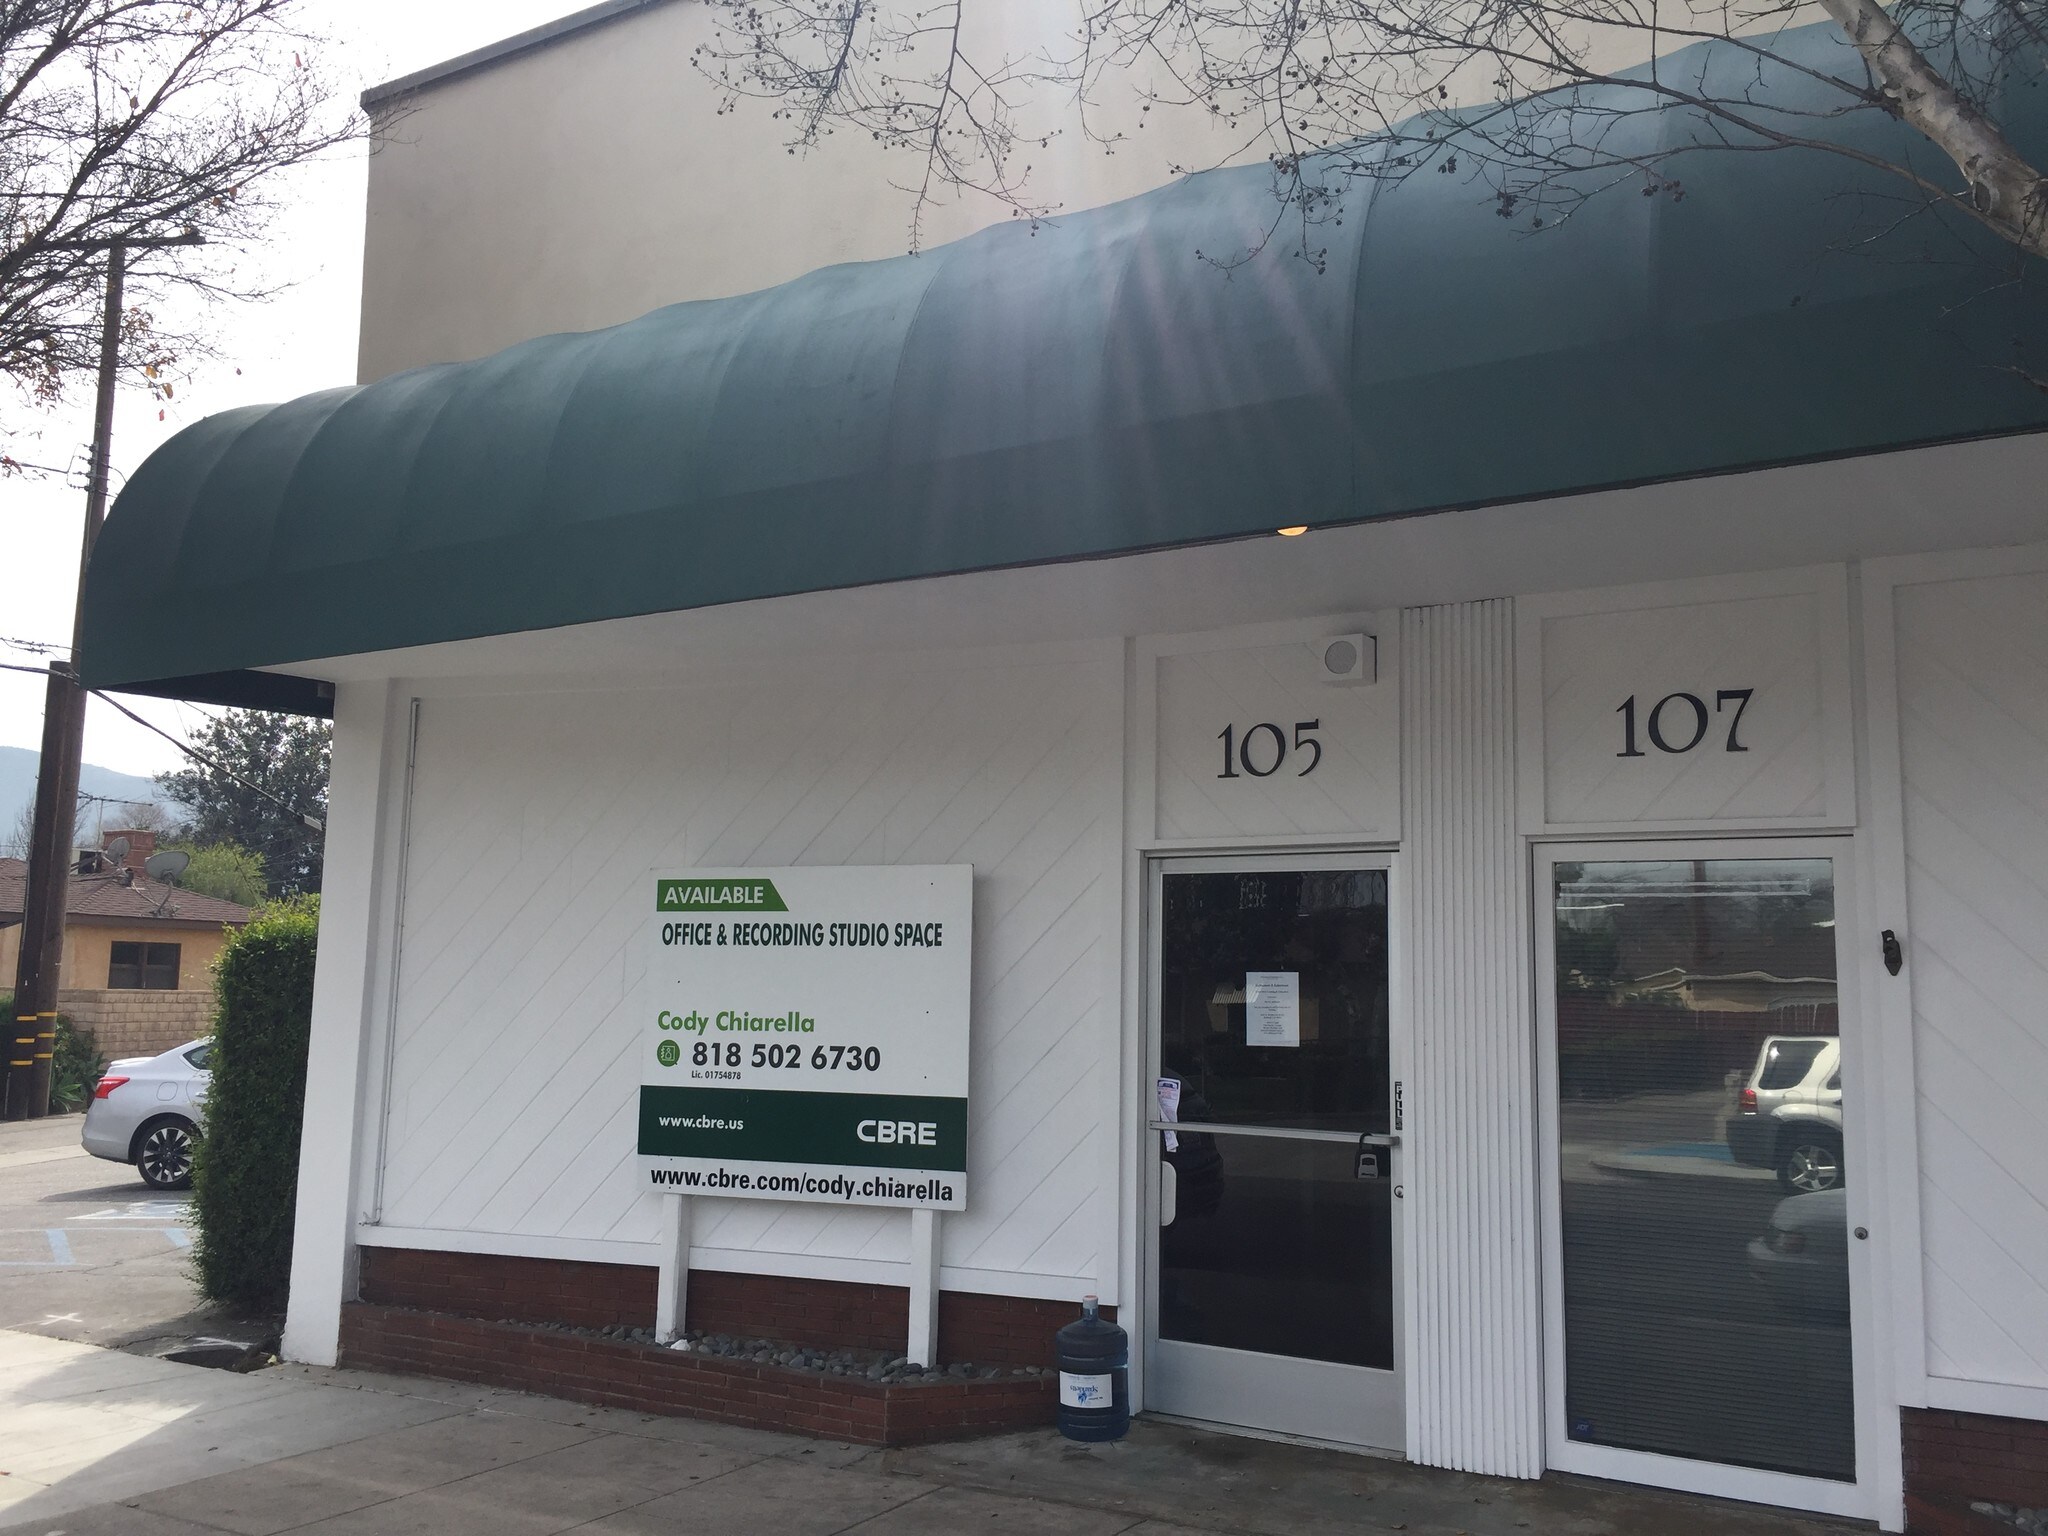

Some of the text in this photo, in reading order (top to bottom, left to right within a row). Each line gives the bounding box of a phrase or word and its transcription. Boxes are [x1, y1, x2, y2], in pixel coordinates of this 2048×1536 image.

[1616, 687, 1754, 757] 107
[1217, 718, 1321, 779] 105
[663, 886, 764, 905] AVAILABLE
[661, 922, 943, 948] OFFICE & RECORDING STUDIO SPACE
[657, 1010, 815, 1036] Cody Chiarella
[692, 1042, 881, 1072] 818 502 6730
[691, 1070, 742, 1080] Lic. 01754878
[659, 1114, 744, 1131] www.cbre.us
[856, 1119, 937, 1146] CBRE
[651, 1168, 953, 1202] www.cbre.com/cody.chiarella
